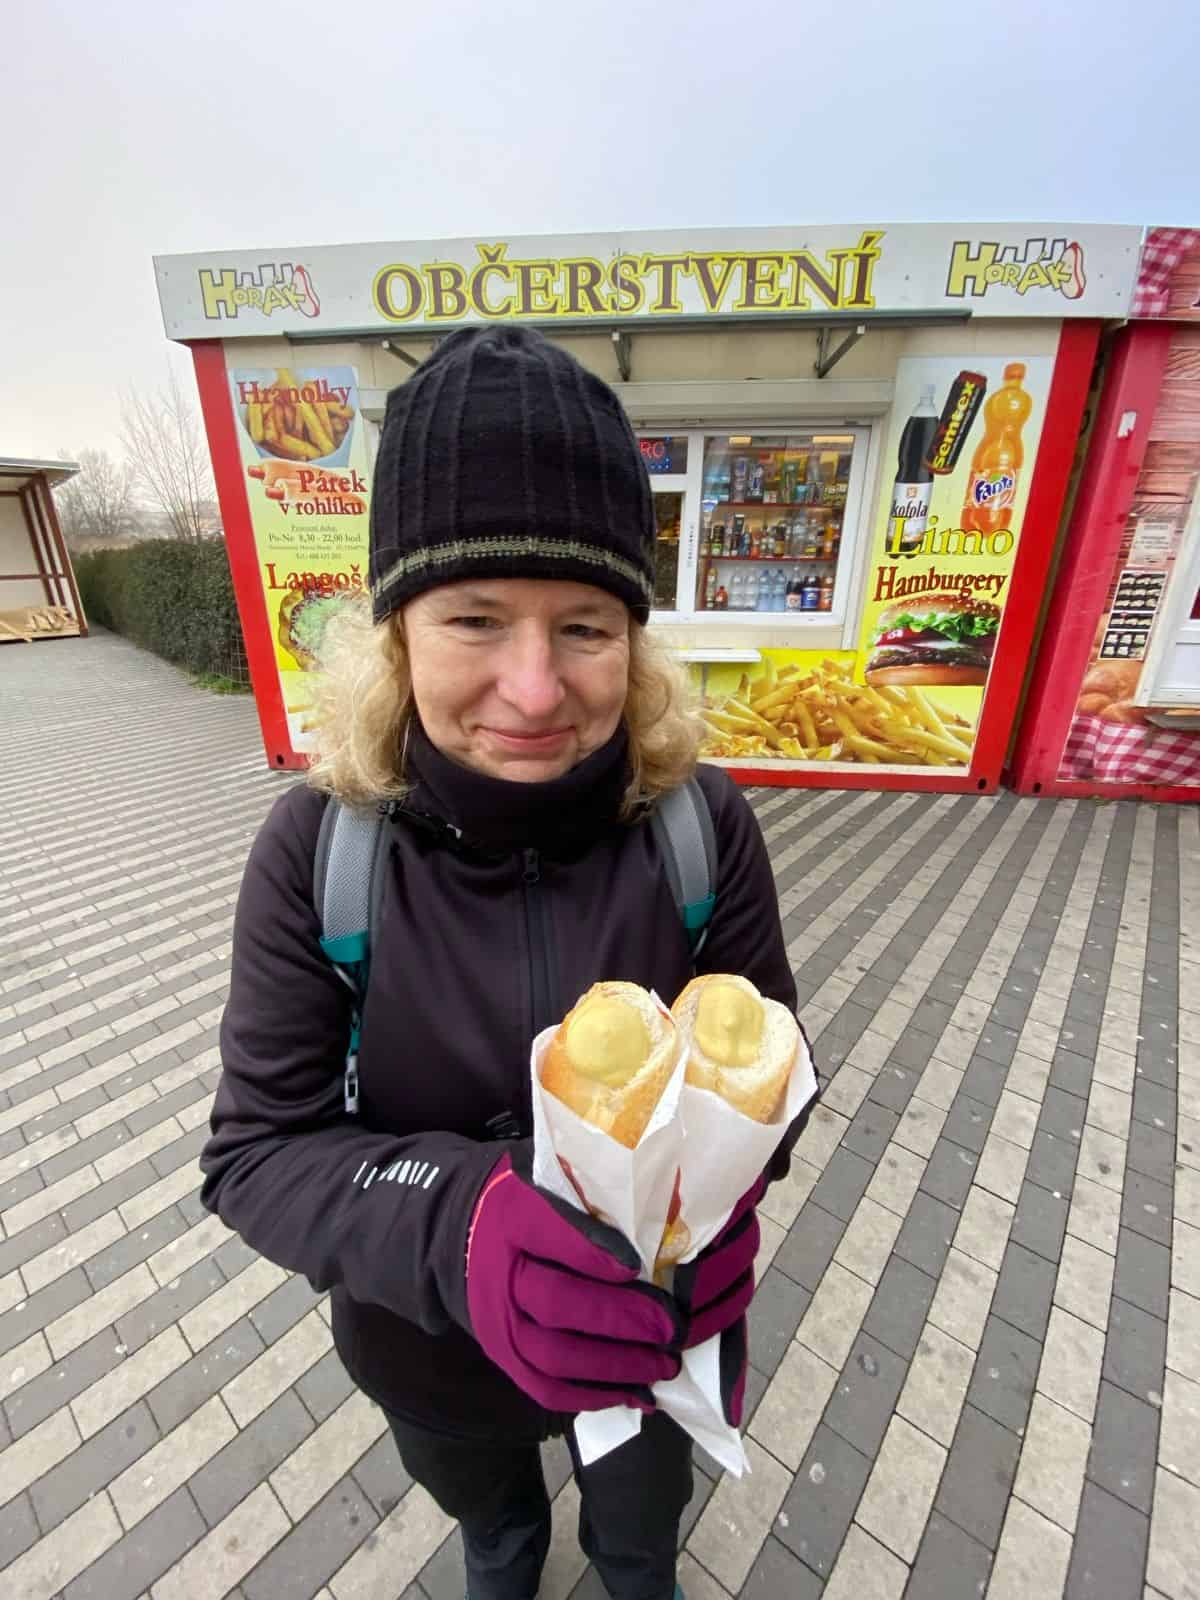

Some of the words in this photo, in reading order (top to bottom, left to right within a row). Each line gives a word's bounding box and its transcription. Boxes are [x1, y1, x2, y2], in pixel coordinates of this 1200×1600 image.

[372, 231, 885, 321] OBČERSTVENÍ
[237, 379, 351, 407] Hranolky
[931, 381, 976, 469] semtex
[296, 470, 368, 493] Párek
[280, 502, 289, 516] v
[296, 497, 364, 516] rohlíku
[890, 500, 928, 519] kofola
[887, 515, 1014, 557] Limo
[873, 566, 1007, 602] Hamburgery
